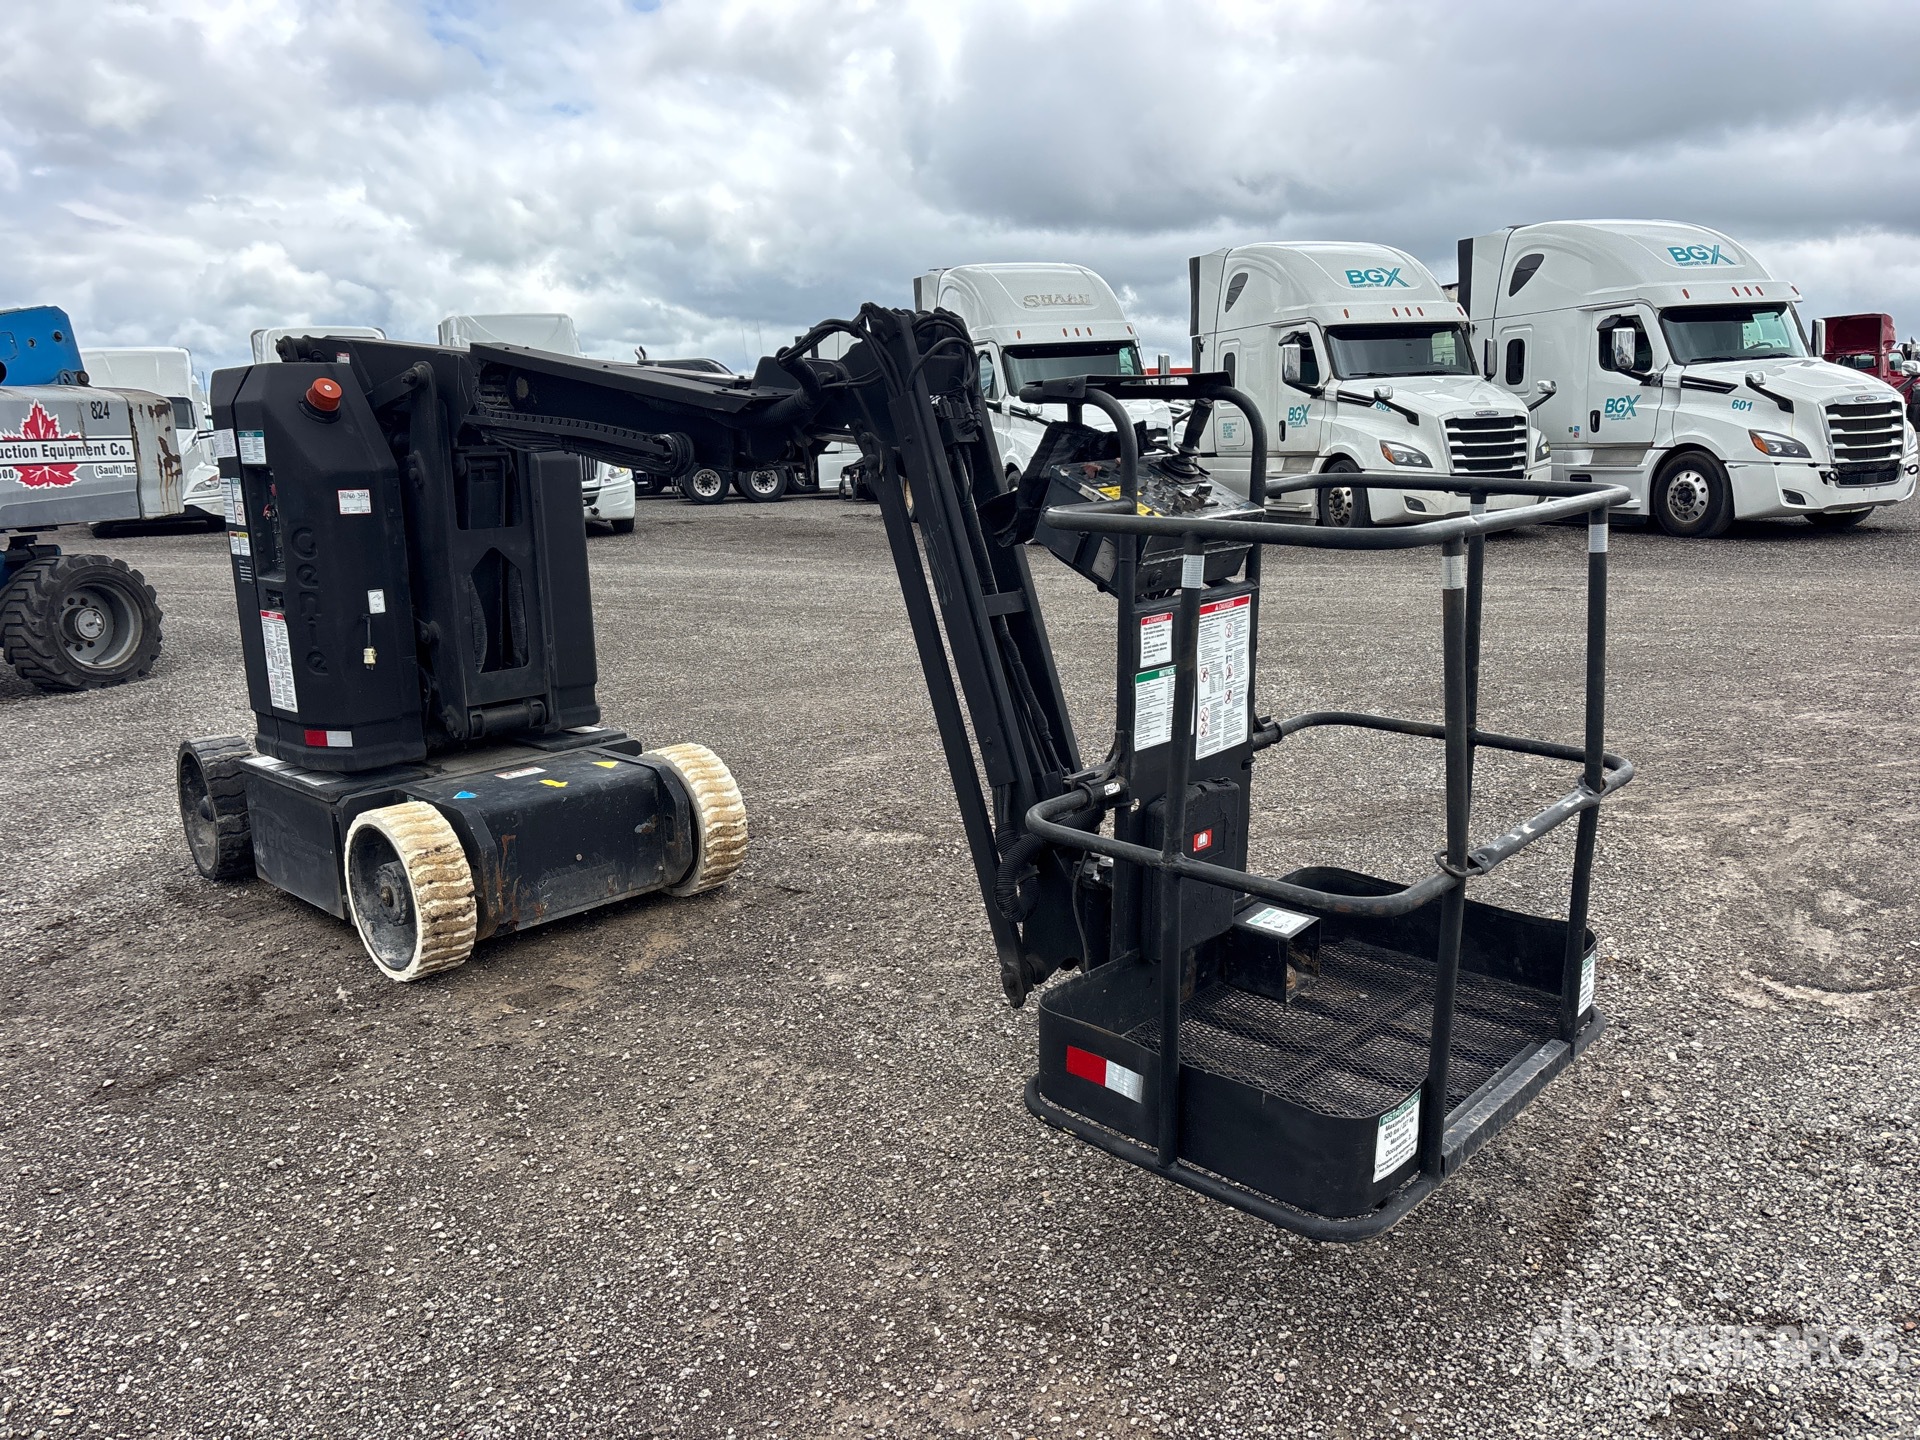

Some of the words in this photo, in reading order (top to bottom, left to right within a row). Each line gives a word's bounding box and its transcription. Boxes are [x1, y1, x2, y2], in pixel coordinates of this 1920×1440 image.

[1667, 244, 1736, 265] BGX
[1345, 268, 1409, 287] BGX
[90, 401, 110, 419] 824
[1288, 404, 1311, 424] BGX
[1605, 394, 1641, 416] BGX
[1732, 400, 1753, 411] 601
[41, 444, 107, 460] Equipment
[110, 442, 130, 456] Co.
[95, 465, 122, 476] (Sault)
[291, 527, 330, 676] Genie
